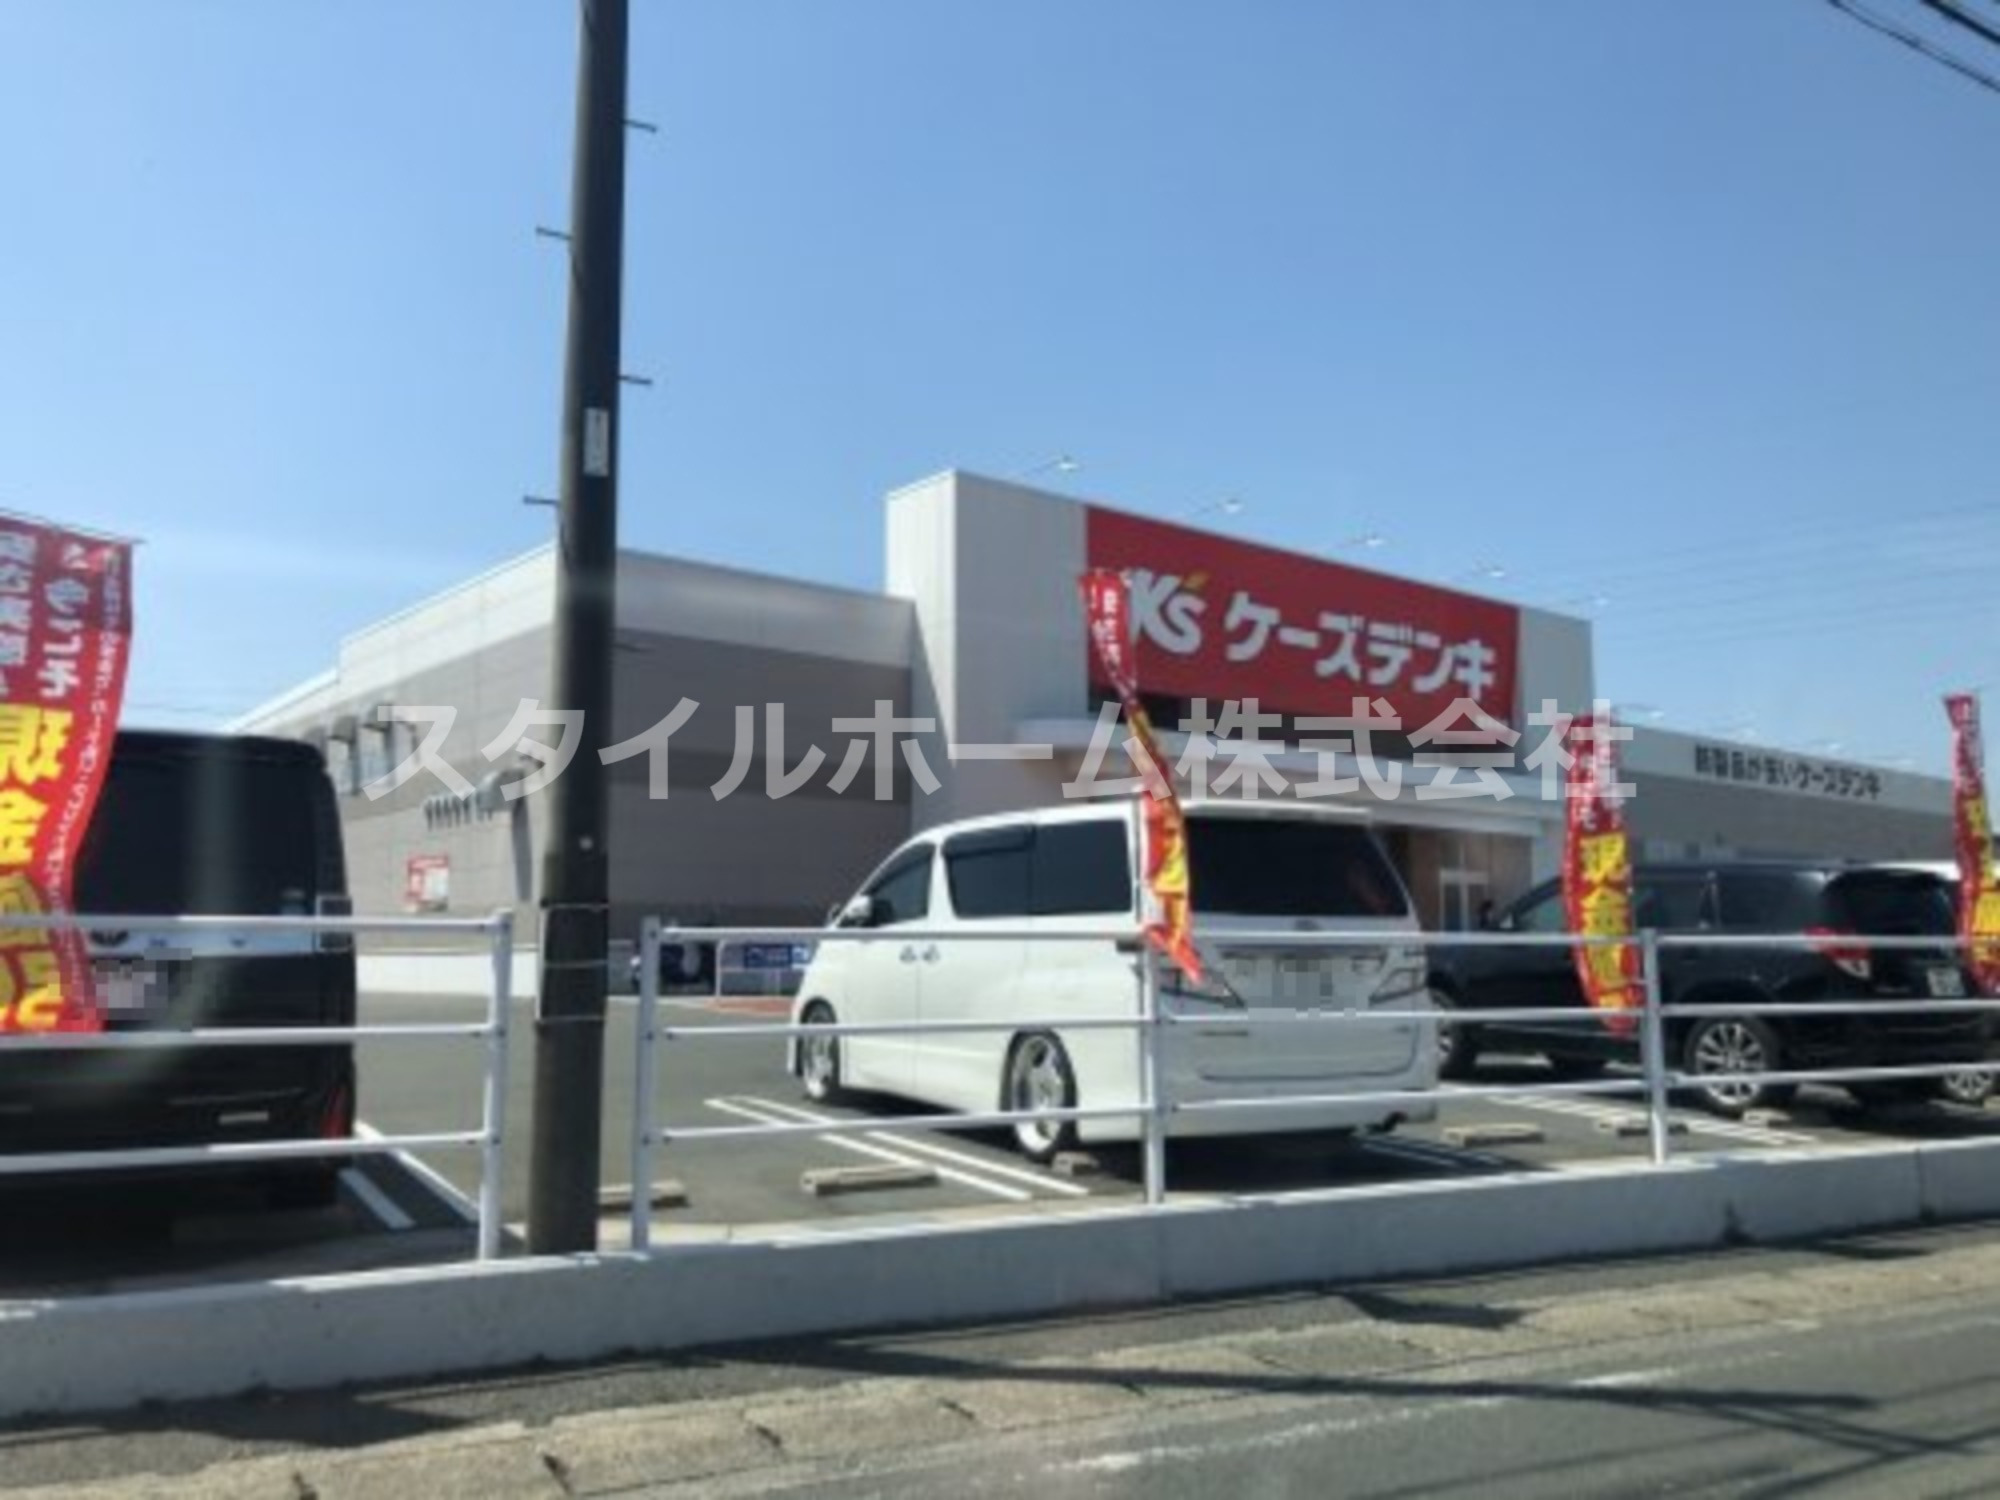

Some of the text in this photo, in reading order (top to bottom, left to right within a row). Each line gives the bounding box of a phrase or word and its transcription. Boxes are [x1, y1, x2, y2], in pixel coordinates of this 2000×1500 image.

[1223, 592, 1495, 700] ケーズデンキ
